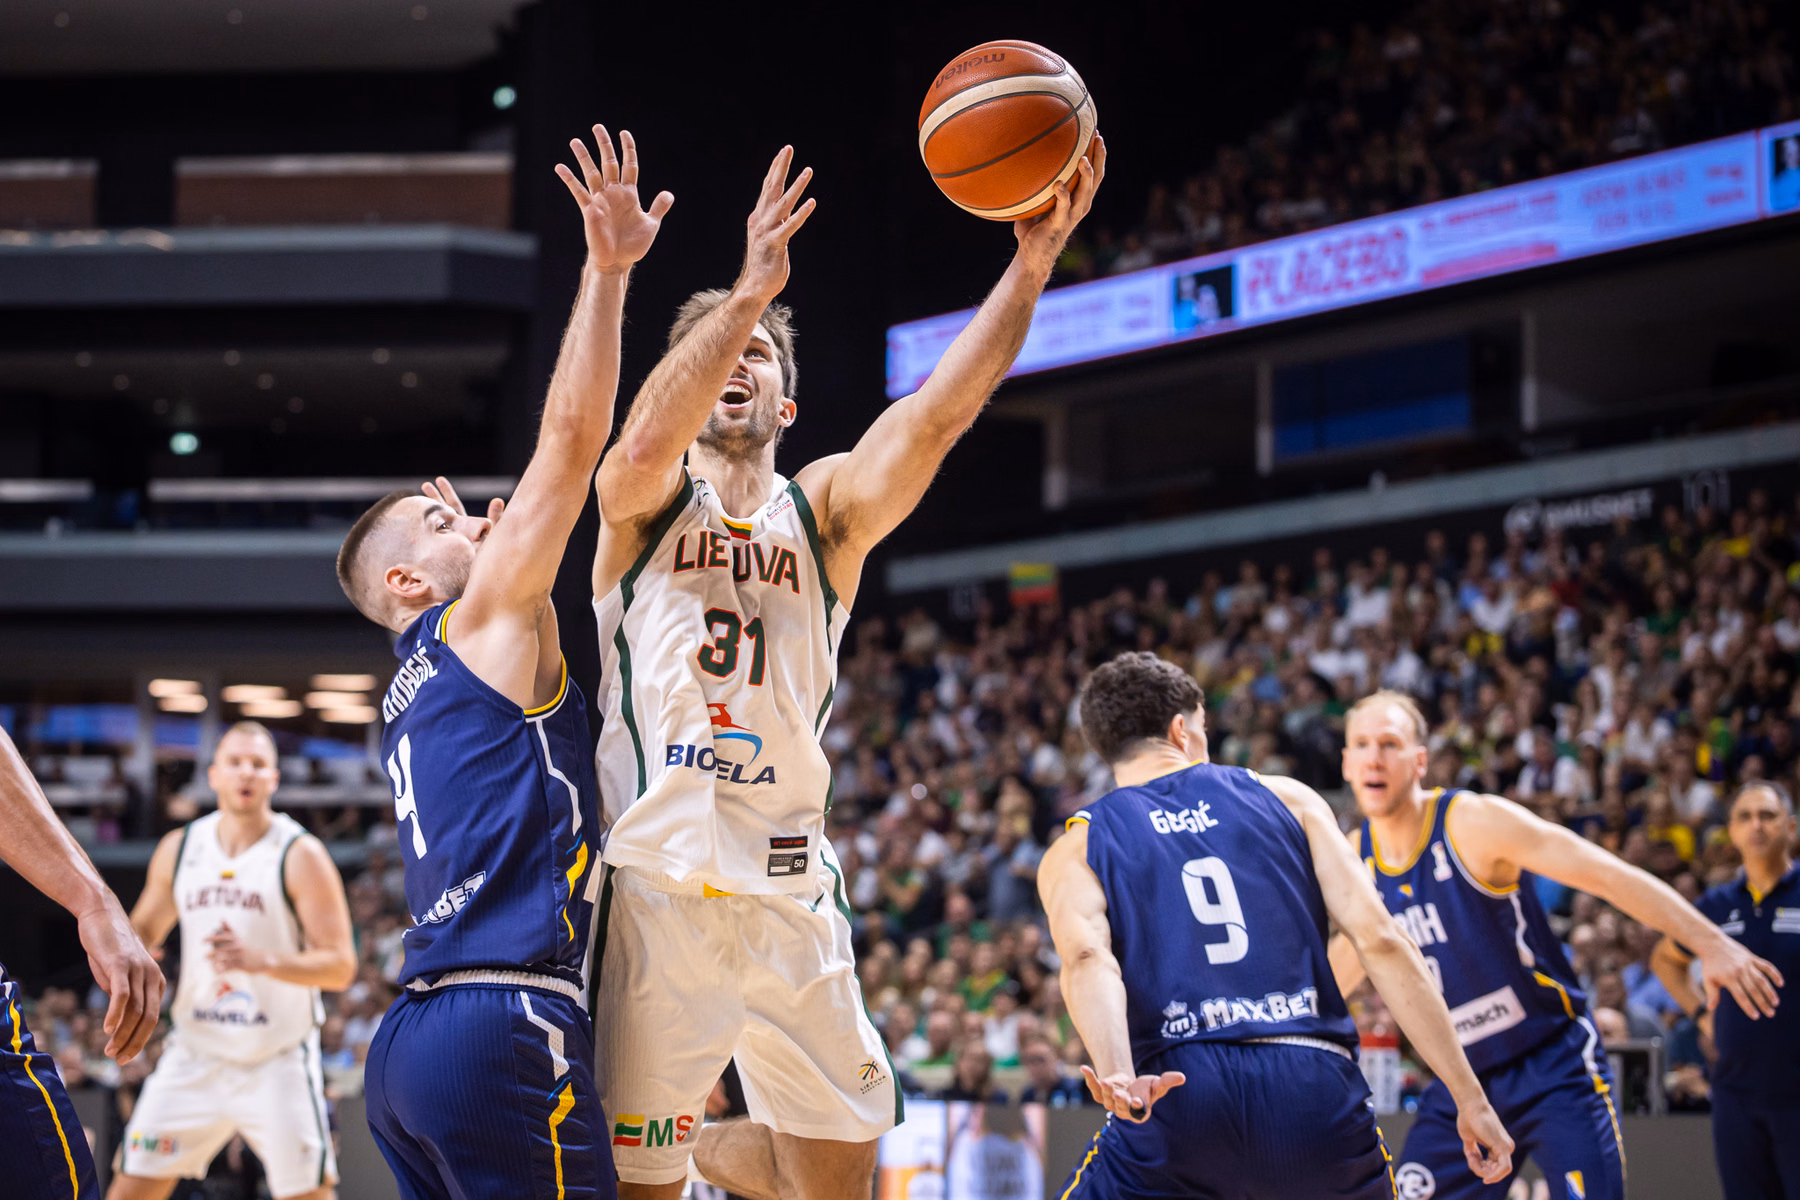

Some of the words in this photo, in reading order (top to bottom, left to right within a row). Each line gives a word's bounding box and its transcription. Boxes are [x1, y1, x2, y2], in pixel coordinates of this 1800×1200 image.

[935, 53, 1005, 89] molten
[1247, 227, 1407, 308] PLACEBO
[673, 530, 800, 594] LIEUVA
[696, 607, 766, 686] 31
[387, 732, 428, 860] 4
[666, 744, 776, 785] BIOELA
[1149, 799, 1219, 835] GEGIĆ
[793, 858, 805, 869] 50
[1181, 856, 1249, 964] 9
